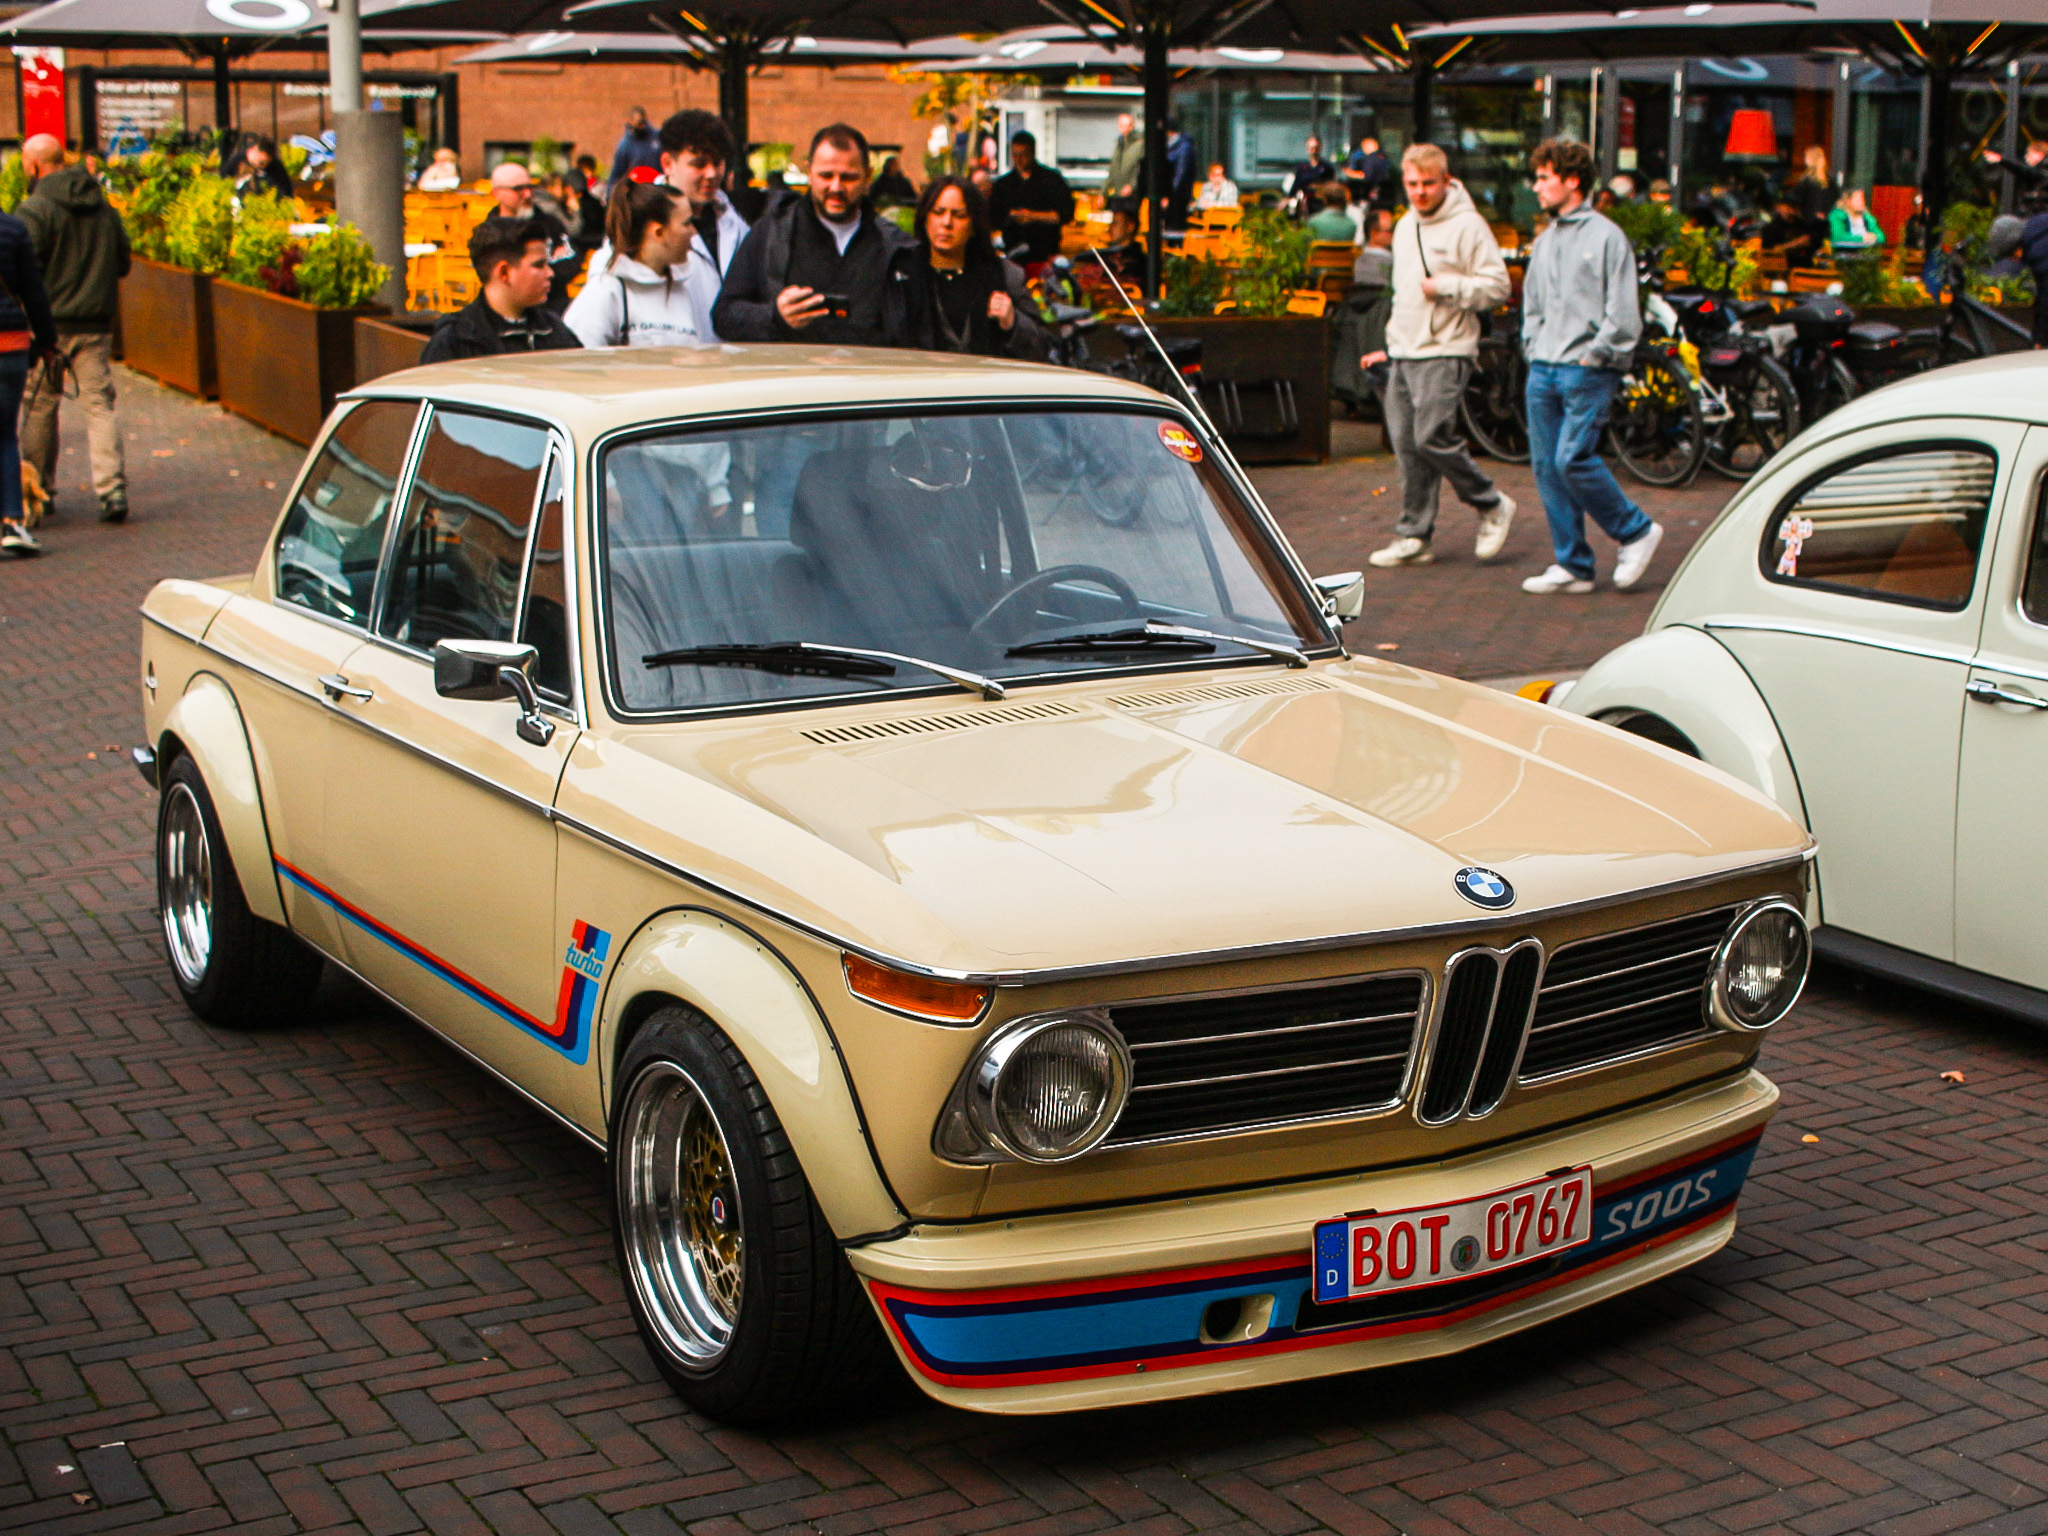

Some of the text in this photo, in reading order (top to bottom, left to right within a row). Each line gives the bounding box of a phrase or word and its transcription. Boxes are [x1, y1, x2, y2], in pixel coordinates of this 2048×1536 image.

[566, 942, 603, 978] turbo
[1352, 1215, 1449, 1287] BOT
[1487, 1178, 1582, 1260] 0767
[1326, 1269, 1338, 1286] D
